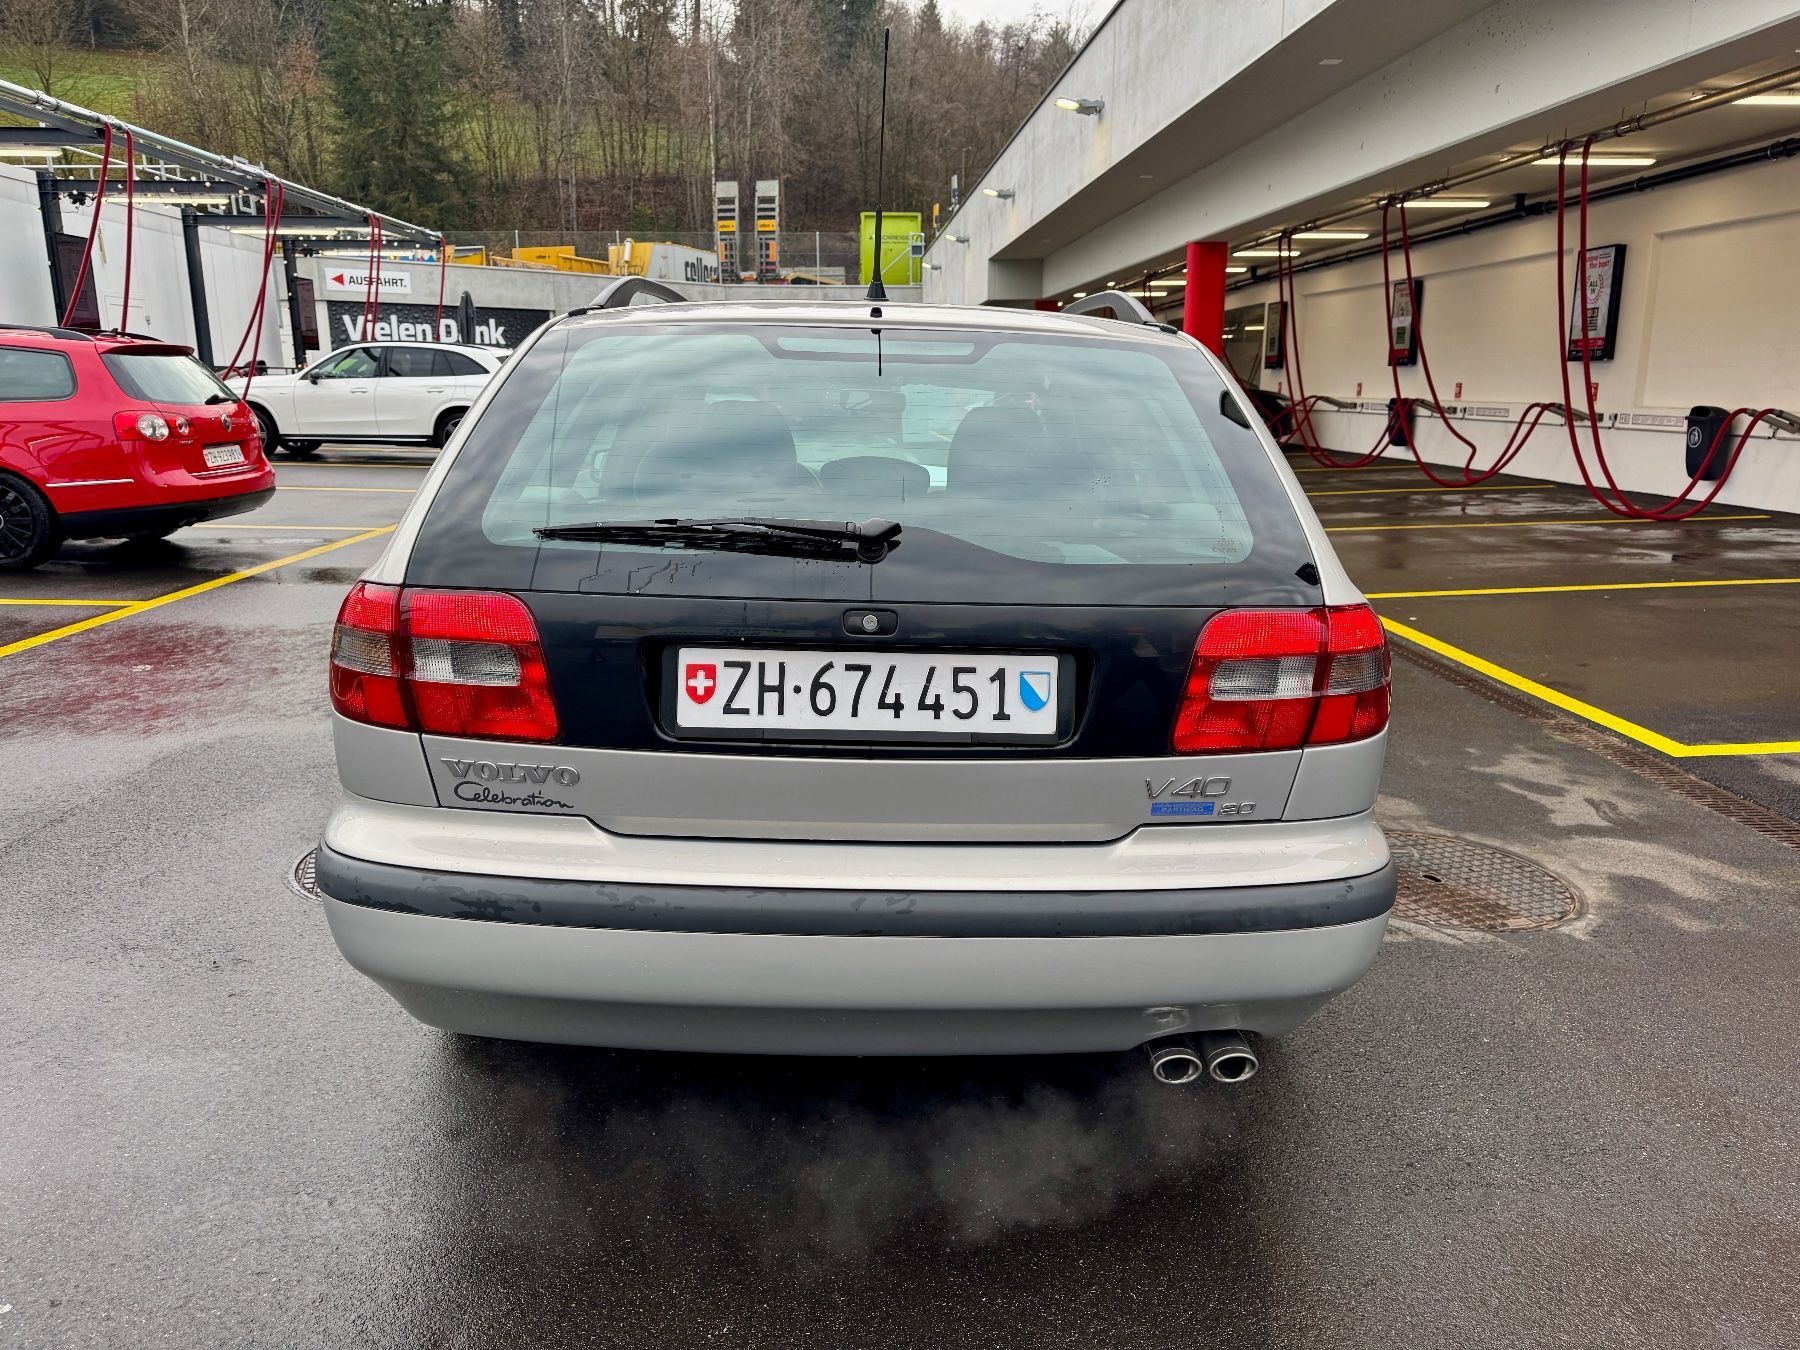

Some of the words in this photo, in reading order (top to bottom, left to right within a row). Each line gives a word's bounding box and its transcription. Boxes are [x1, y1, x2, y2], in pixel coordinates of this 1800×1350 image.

[342, 314, 433, 341] Vielen
[439, 318, 507, 345] Dnk
[440, 757, 580, 787] VOLVO
[453, 780, 574, 809] Celebration
[1145, 776, 1233, 800] V40
